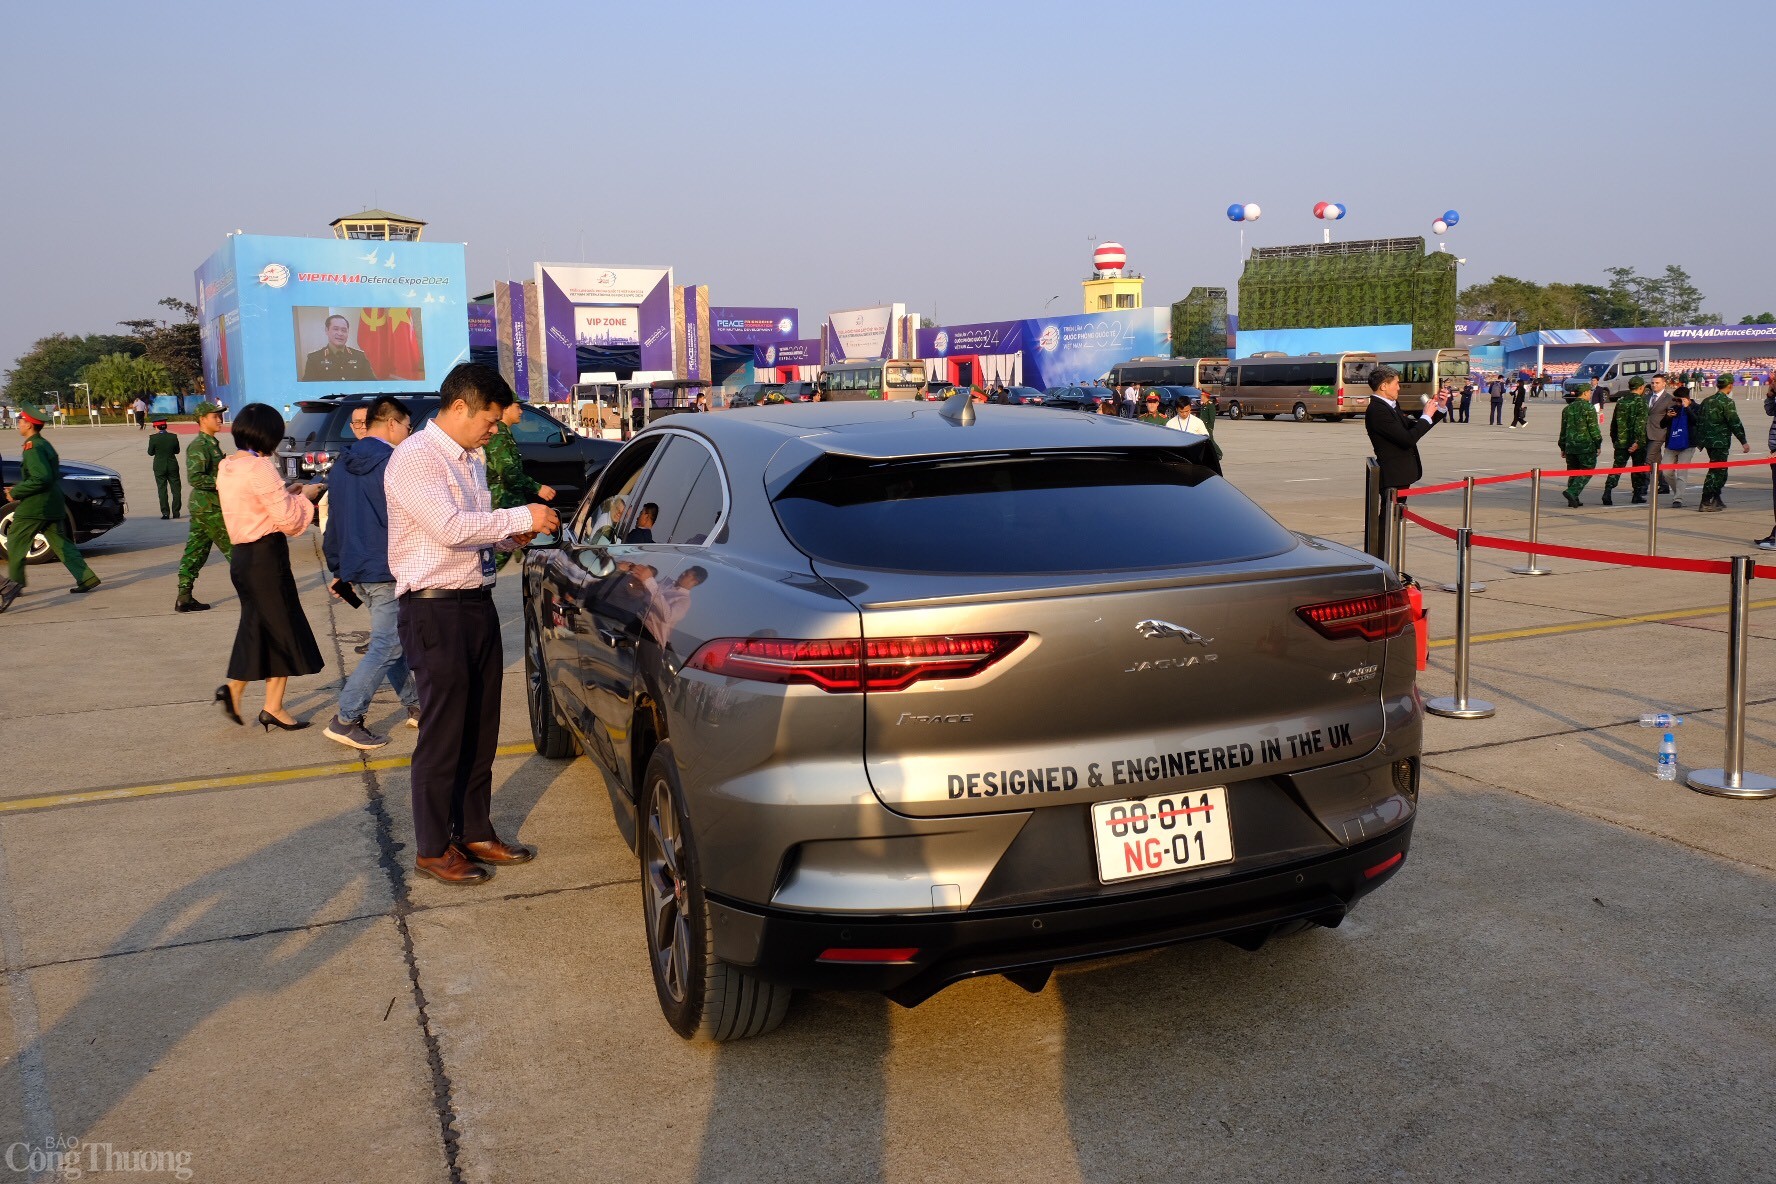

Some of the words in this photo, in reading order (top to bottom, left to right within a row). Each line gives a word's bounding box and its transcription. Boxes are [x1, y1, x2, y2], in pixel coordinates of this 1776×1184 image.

[586, 317, 601, 326] VIP
[603, 318, 627, 326] ZONE
[717, 320, 744, 328] PEACE
[1124, 653, 1219, 673] JAGUAR
[947, 766, 1079, 800] DESIGNED
[1087, 762, 1105, 788] &
[1111, 743, 1254, 786] ENGINEERED
[1260, 737, 1282, 764] IN
[1286, 729, 1325, 759] THE
[1328, 723, 1353, 749] UK
[1123, 830, 1206, 874] NG-01
